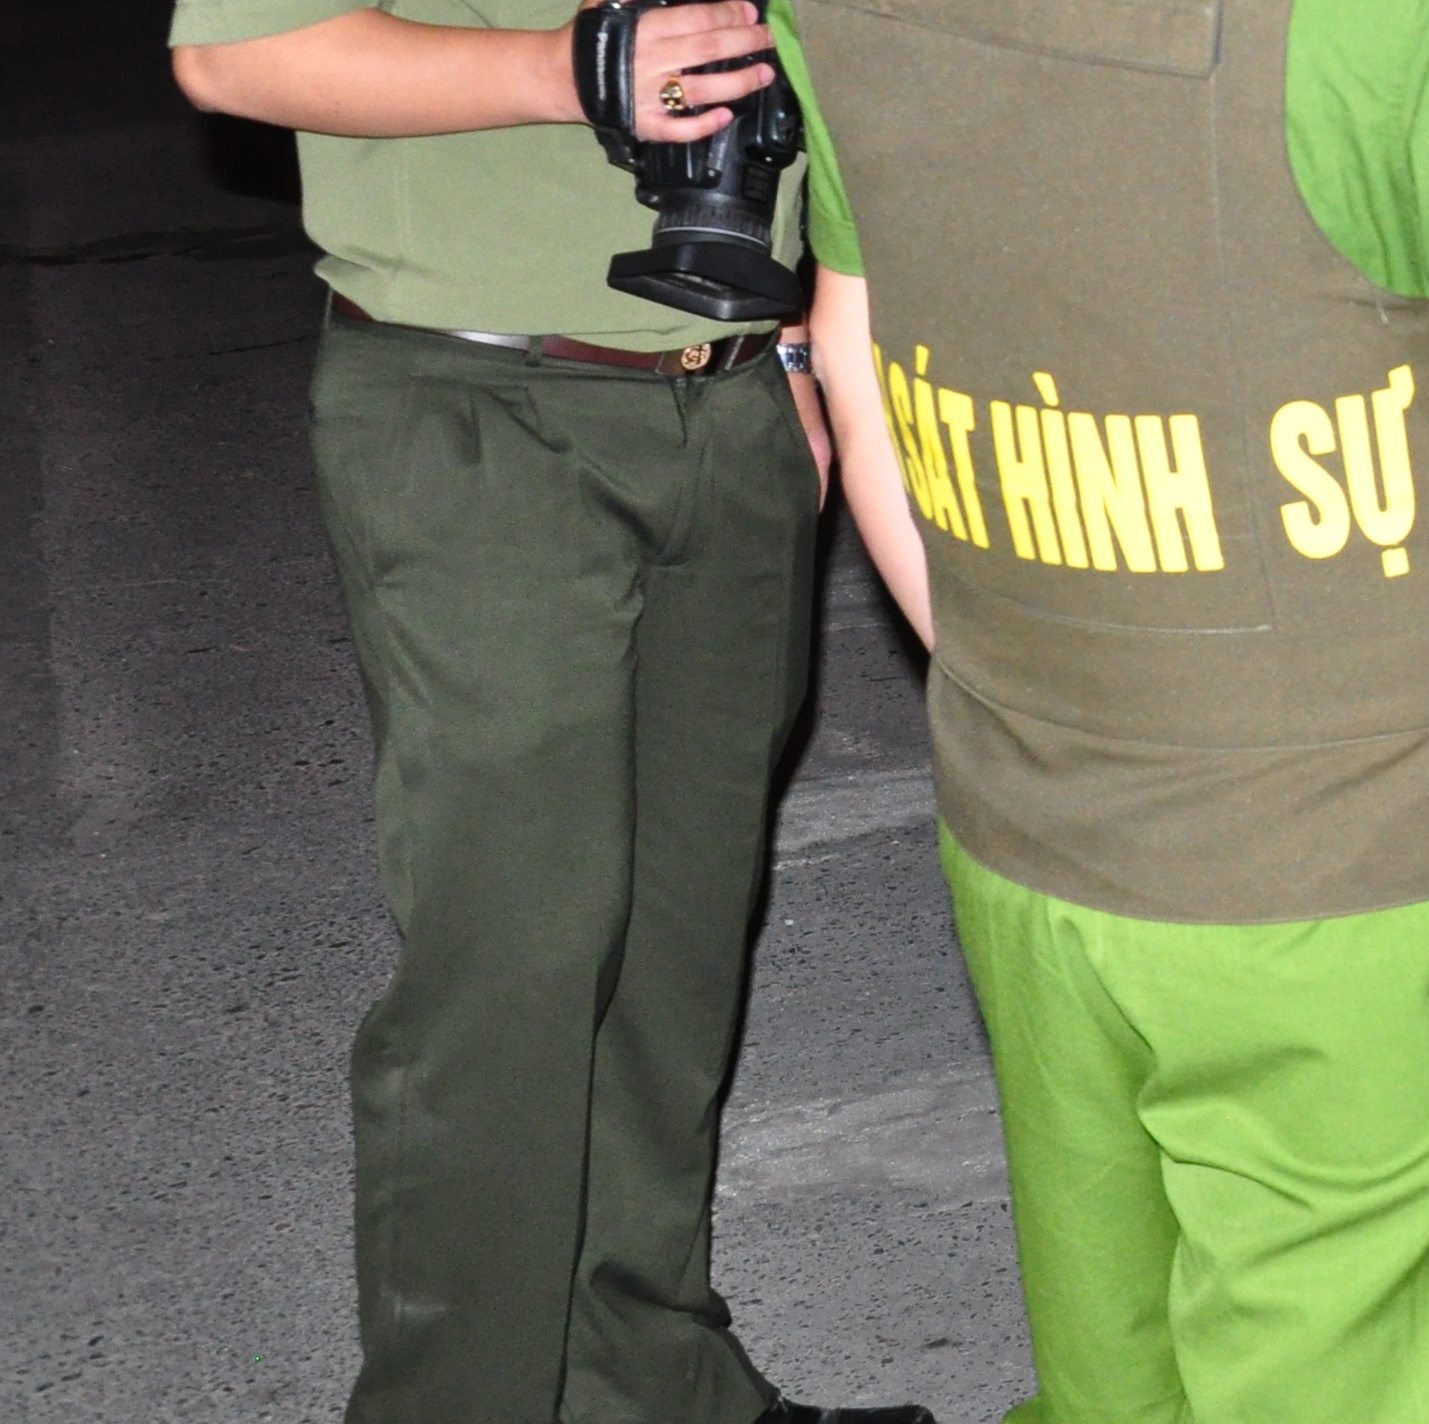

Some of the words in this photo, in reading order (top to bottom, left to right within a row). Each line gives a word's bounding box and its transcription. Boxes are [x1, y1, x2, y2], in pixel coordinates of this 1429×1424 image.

[889, 344, 990, 549] SÁT
[990, 372, 1224, 573] HÌNH
[1270, 364, 1416, 578] SỰ
